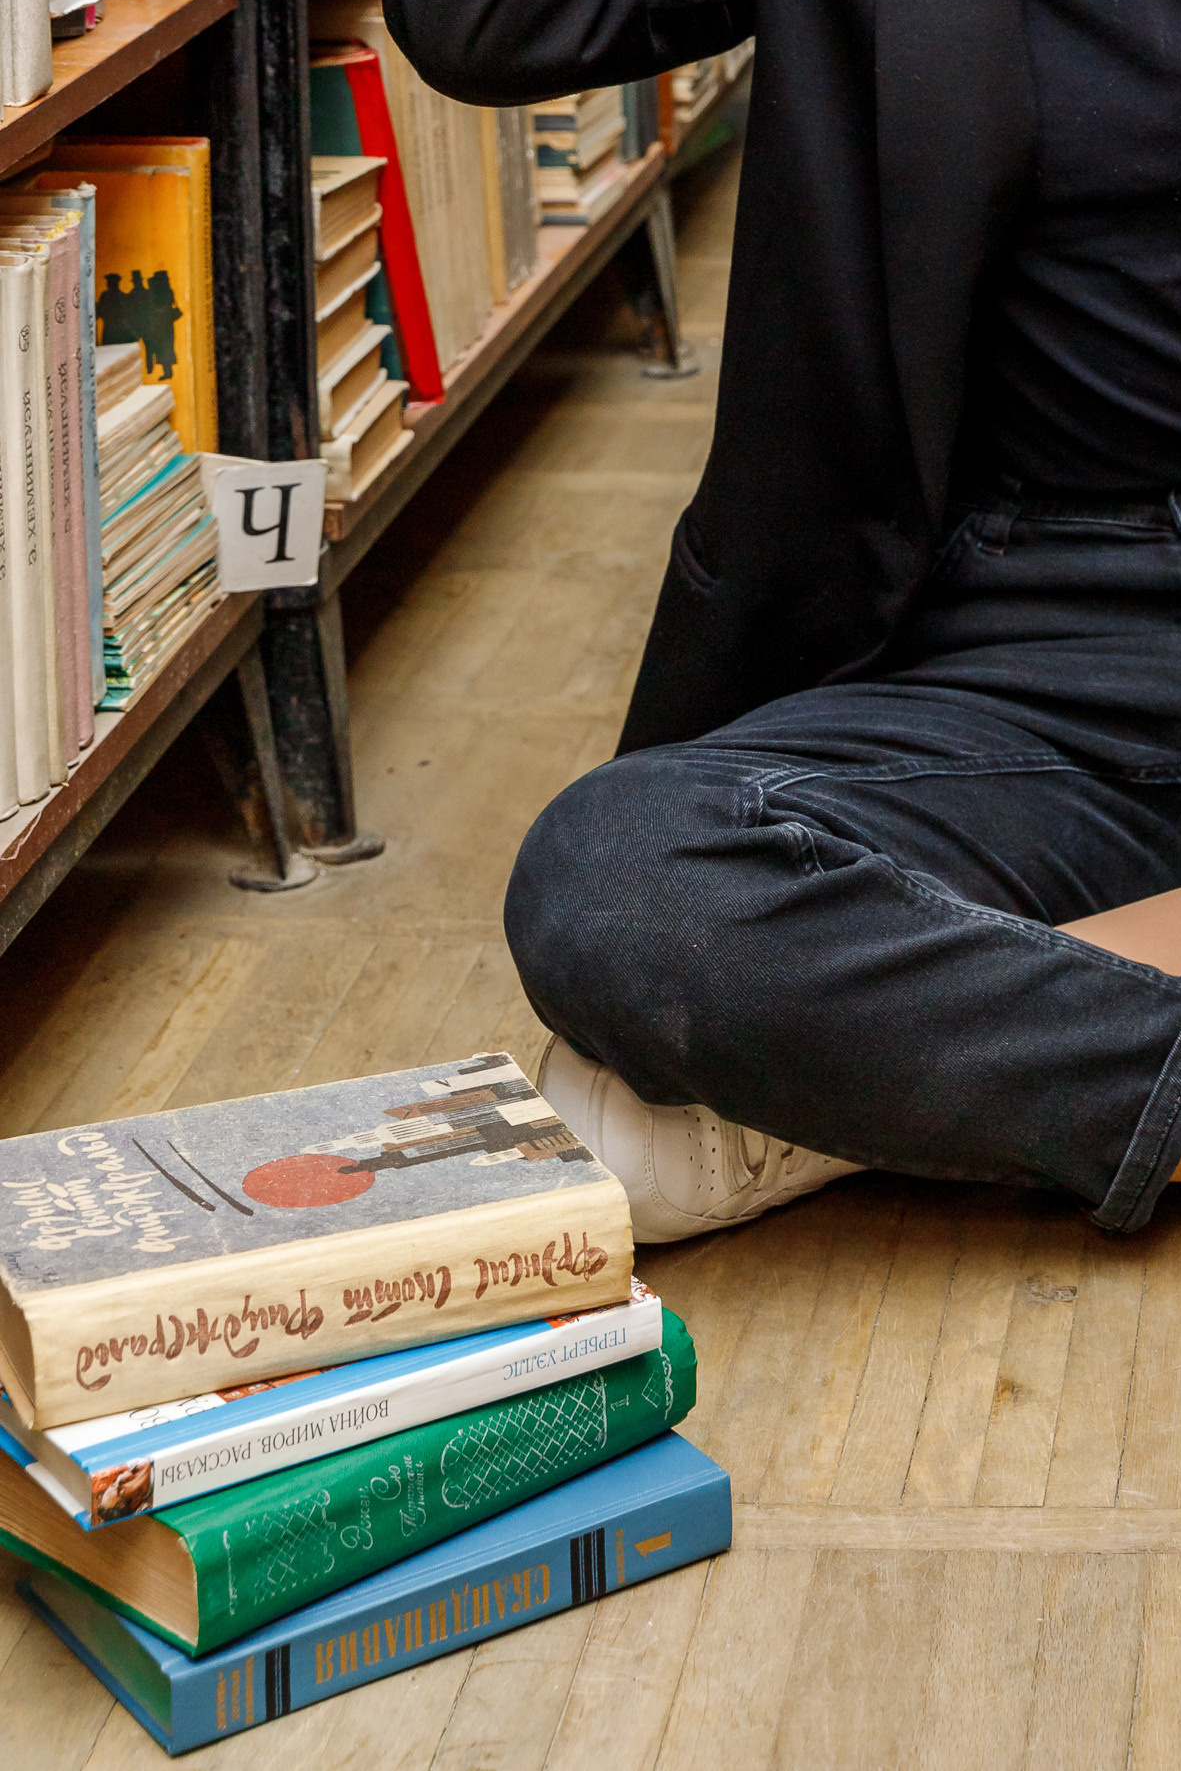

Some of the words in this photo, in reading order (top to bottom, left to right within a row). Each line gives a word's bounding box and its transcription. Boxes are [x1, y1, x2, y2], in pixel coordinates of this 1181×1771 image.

[23, 389, 37, 539] ХЕМИНГУЭЙ
[236, 482, 301, 566] Ч
[474, 1232, 608, 1299] Фрэнсис
[344, 1265, 452, 1326] Скотт
[76, 1288, 324, 1391] Фицджеральд
[502, 1348, 558, 1382] УЭЛЛС
[560, 1327, 628, 1363] ГЕРБЕРТ
[258, 1418, 326, 1455] МИРОВ.
[330, 1398, 390, 1432] ВОЙНА
[160, 1440, 253, 1486] РАССКАЗЫ
[633, 1529, 673, 1559] 1
[314, 1563, 551, 1685] СКАНДИНАВИЯ
